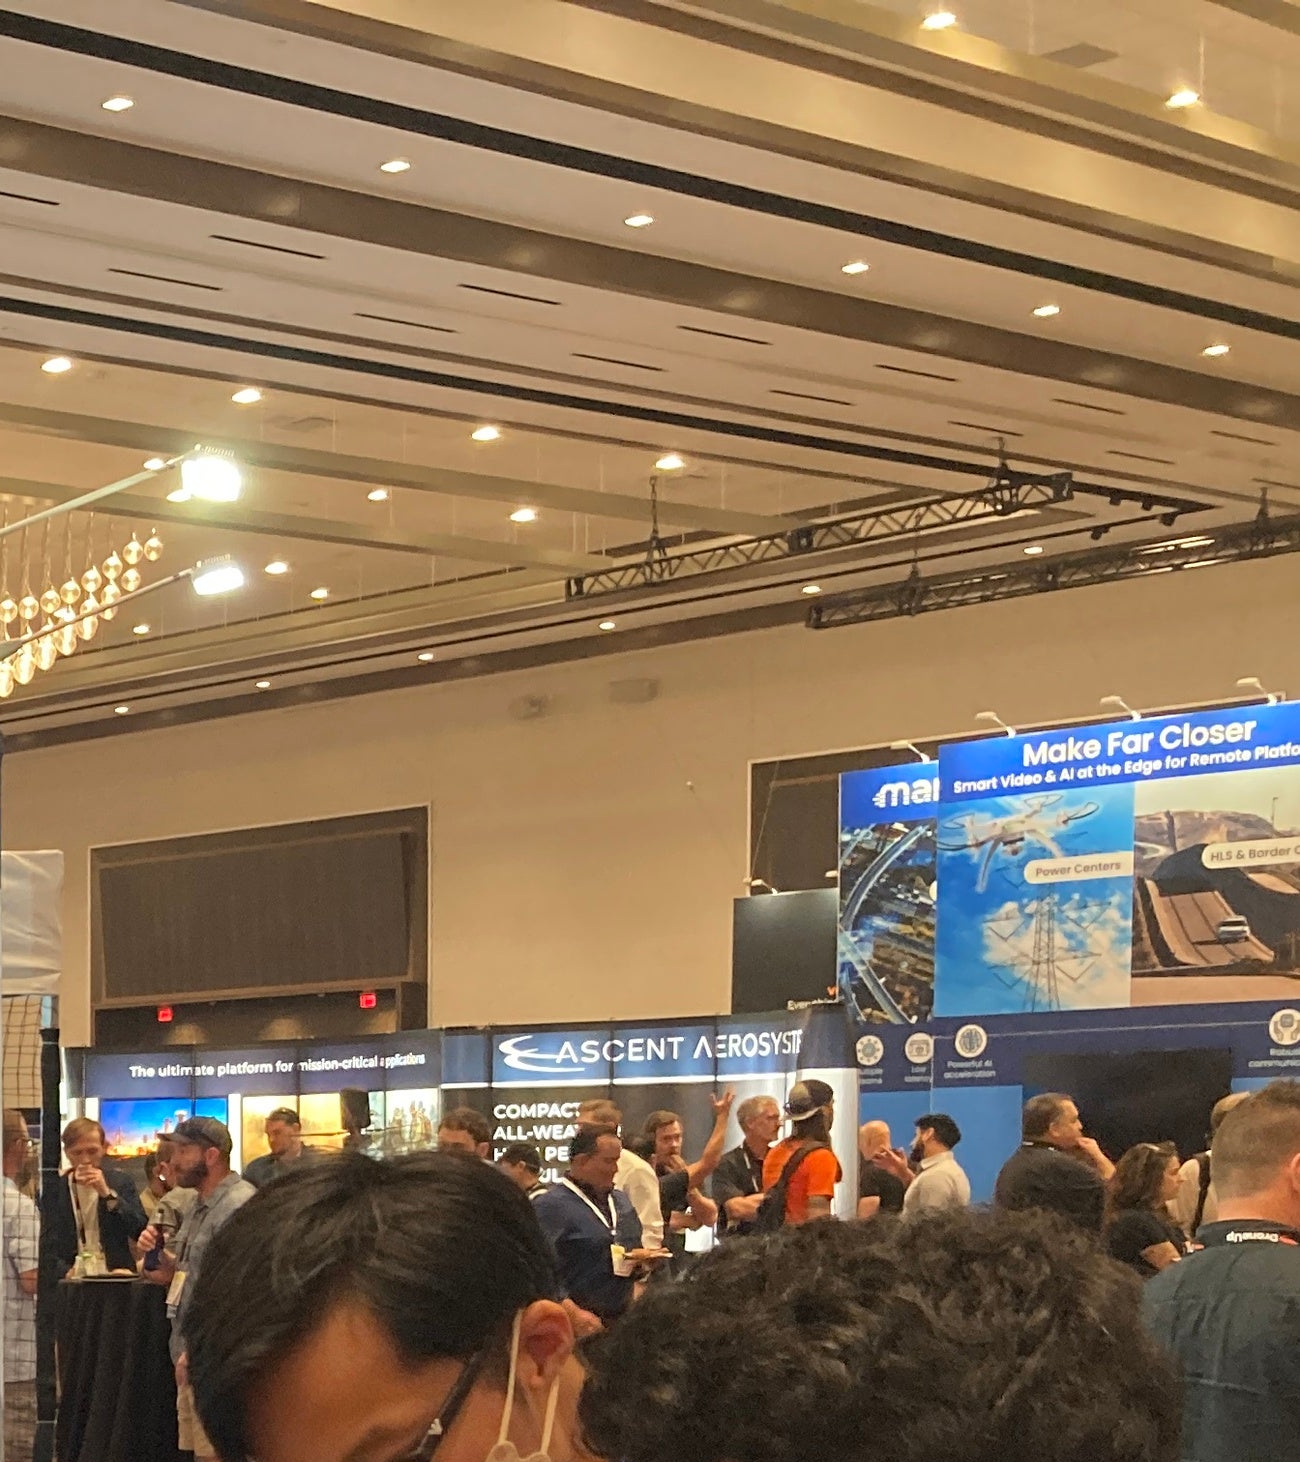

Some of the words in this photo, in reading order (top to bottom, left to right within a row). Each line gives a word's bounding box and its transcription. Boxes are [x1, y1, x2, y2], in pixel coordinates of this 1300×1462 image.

[1022, 738, 1101, 767] Make
[1107, 731, 1155, 757] Far
[1158, 720, 1257, 751] Closer
[953, 778, 998, 794] Smart
[1000, 772, 1042, 789] Video
[1045, 771, 1057, 783] &
[1060, 768, 1075, 781] AI
[1076, 766, 1092, 779] at
[1096, 763, 1121, 777] the
[1124, 758, 1162, 778] Edge
[1165, 754, 1187, 769] for
[1189, 748, 1251, 767] Remote
[1210, 850, 1234, 862] HLS
[1235, 848, 1246, 860] &
[1248, 845, 1292, 858] Border
[1035, 865, 1071, 877] Power
[1073, 861, 1122, 875] Centers
[554, 1036, 686, 1064] ASCENT
[129, 1065, 155, 1078] The
[158, 1063, 215, 1078] ultimate
[217, 1061, 273, 1077] platform
[275, 1060, 294, 1073] for
